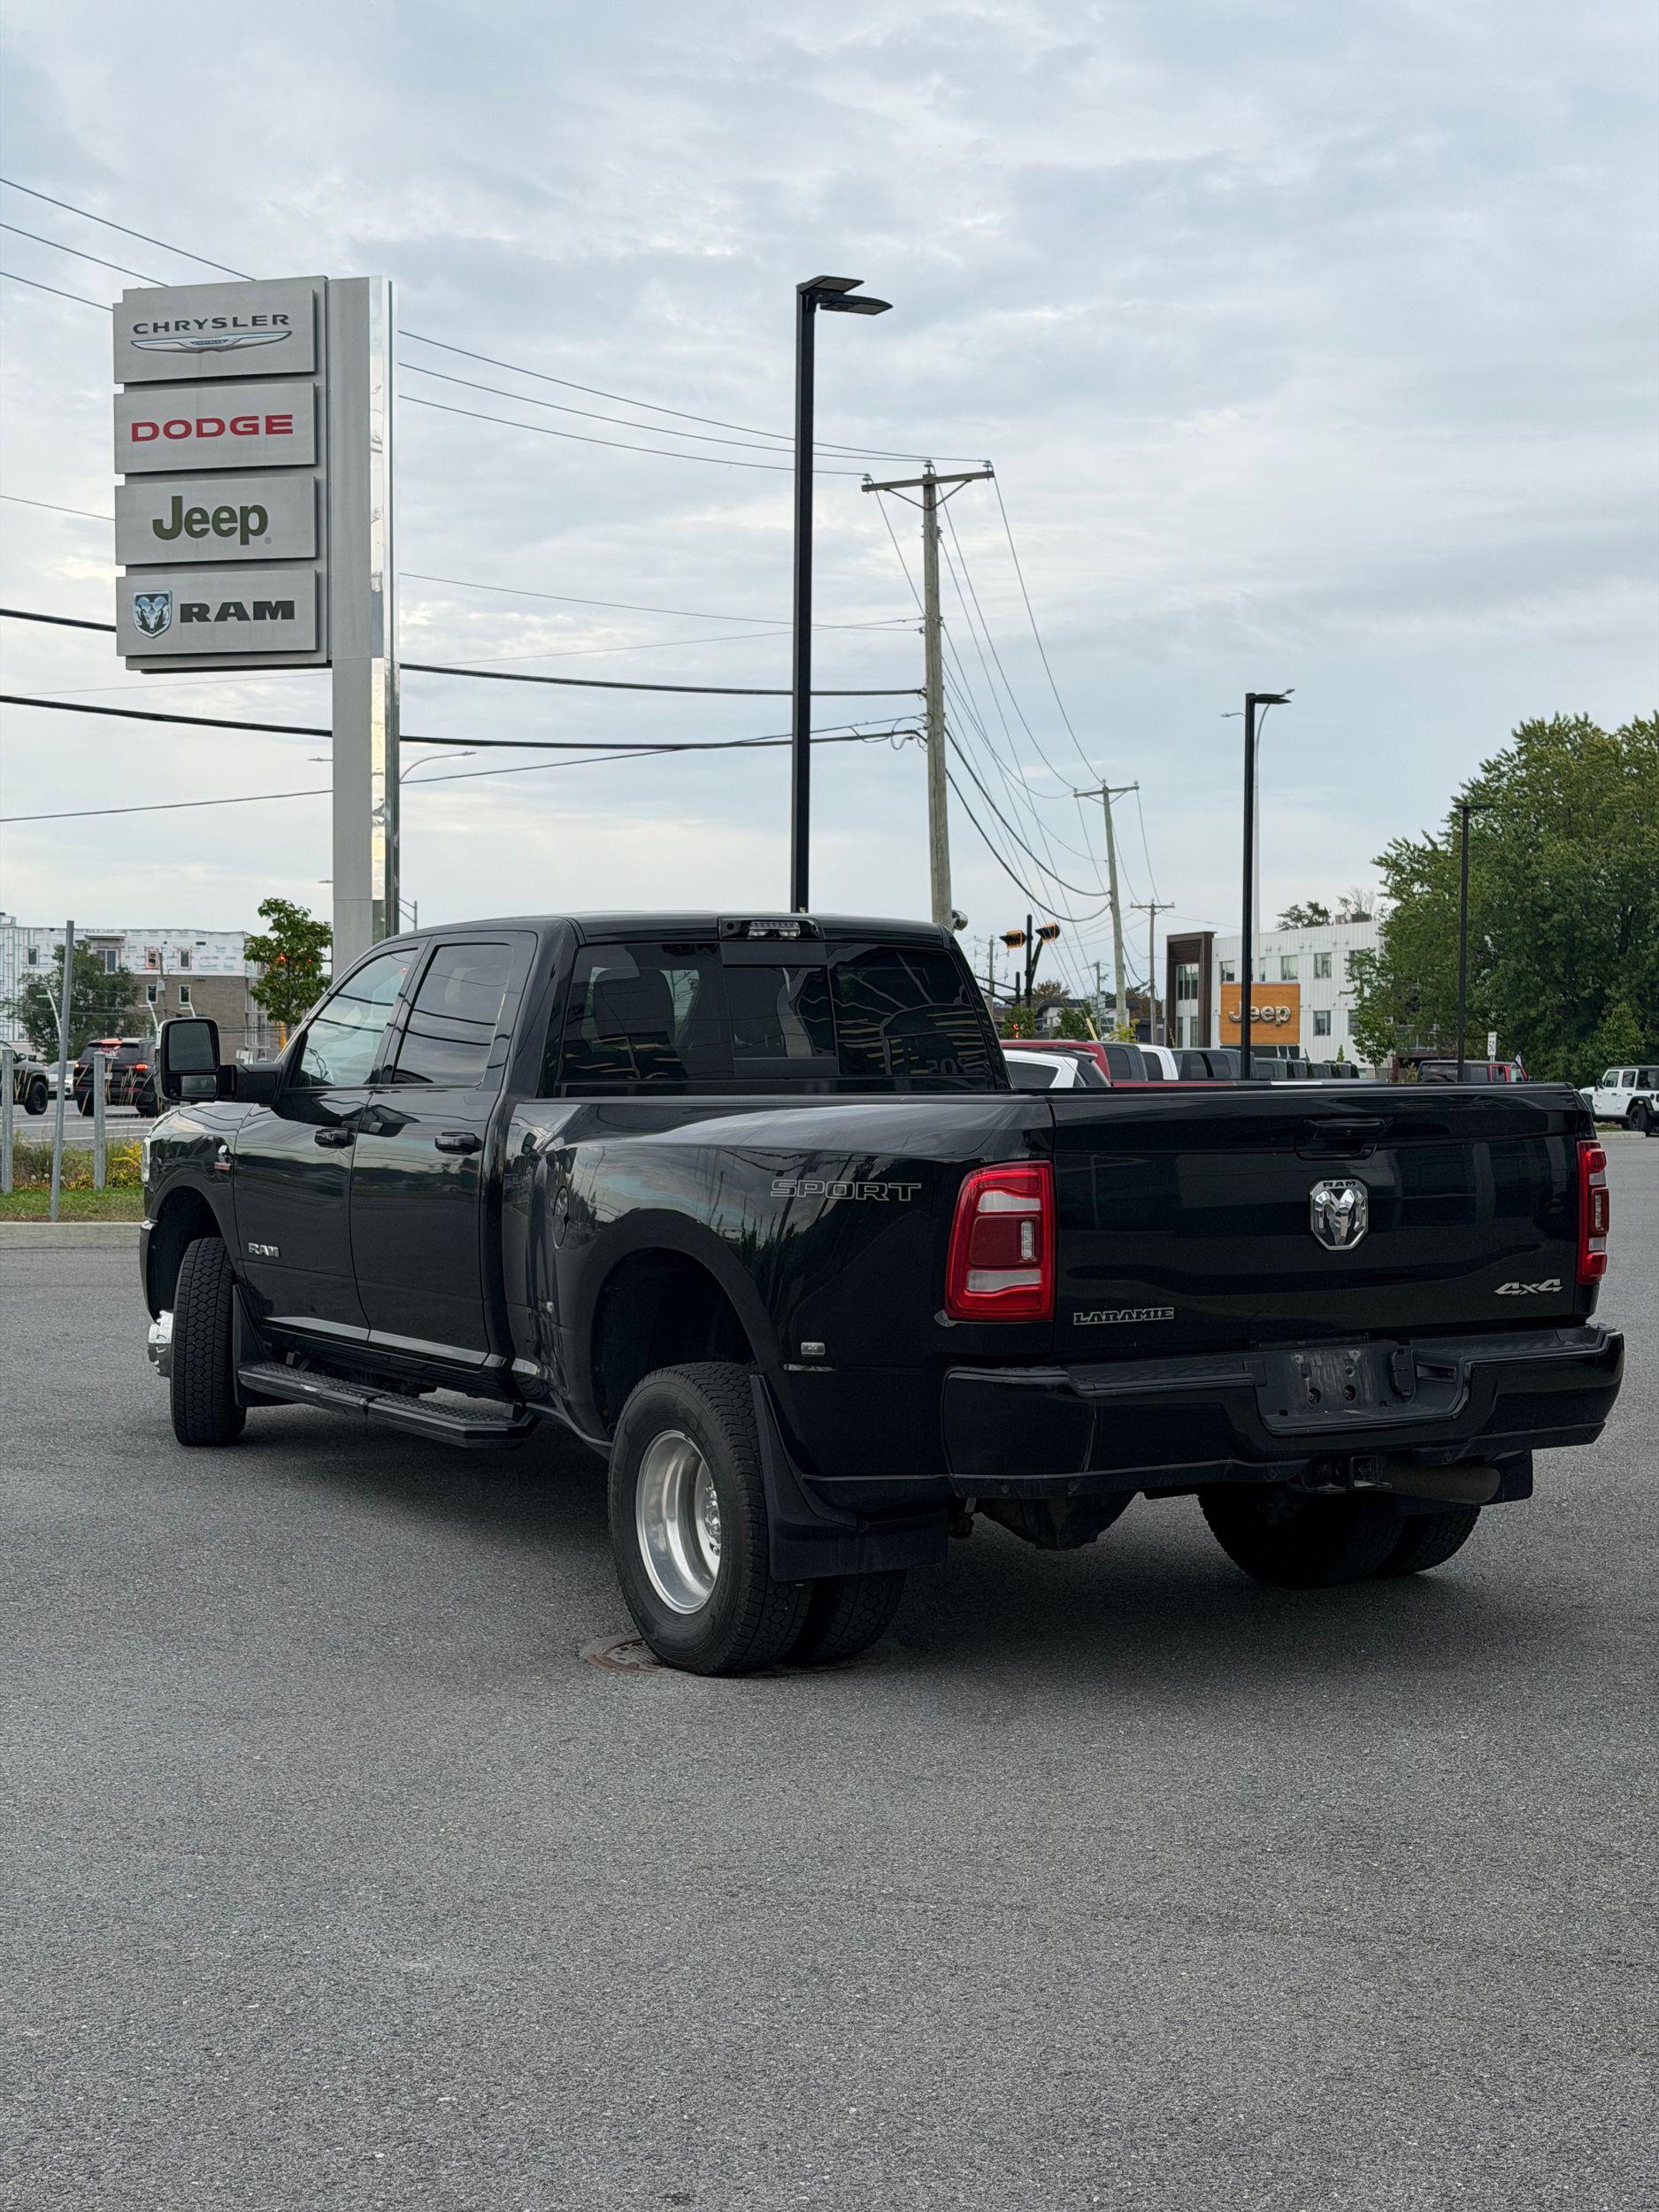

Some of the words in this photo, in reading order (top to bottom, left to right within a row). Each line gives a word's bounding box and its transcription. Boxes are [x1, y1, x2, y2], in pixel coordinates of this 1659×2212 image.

[133, 314, 290, 334] CHRYSLER
[131, 414, 294, 442] DODGE
[152, 495, 269, 545] Jeep
[180, 600, 296, 623] RAM
[1228, 1001, 1292, 1026] Jeep
[771, 1179, 922, 1202] SPORT
[248, 1241, 281, 1257] RAM
[1073, 1307, 1175, 1325] LARAMIE
